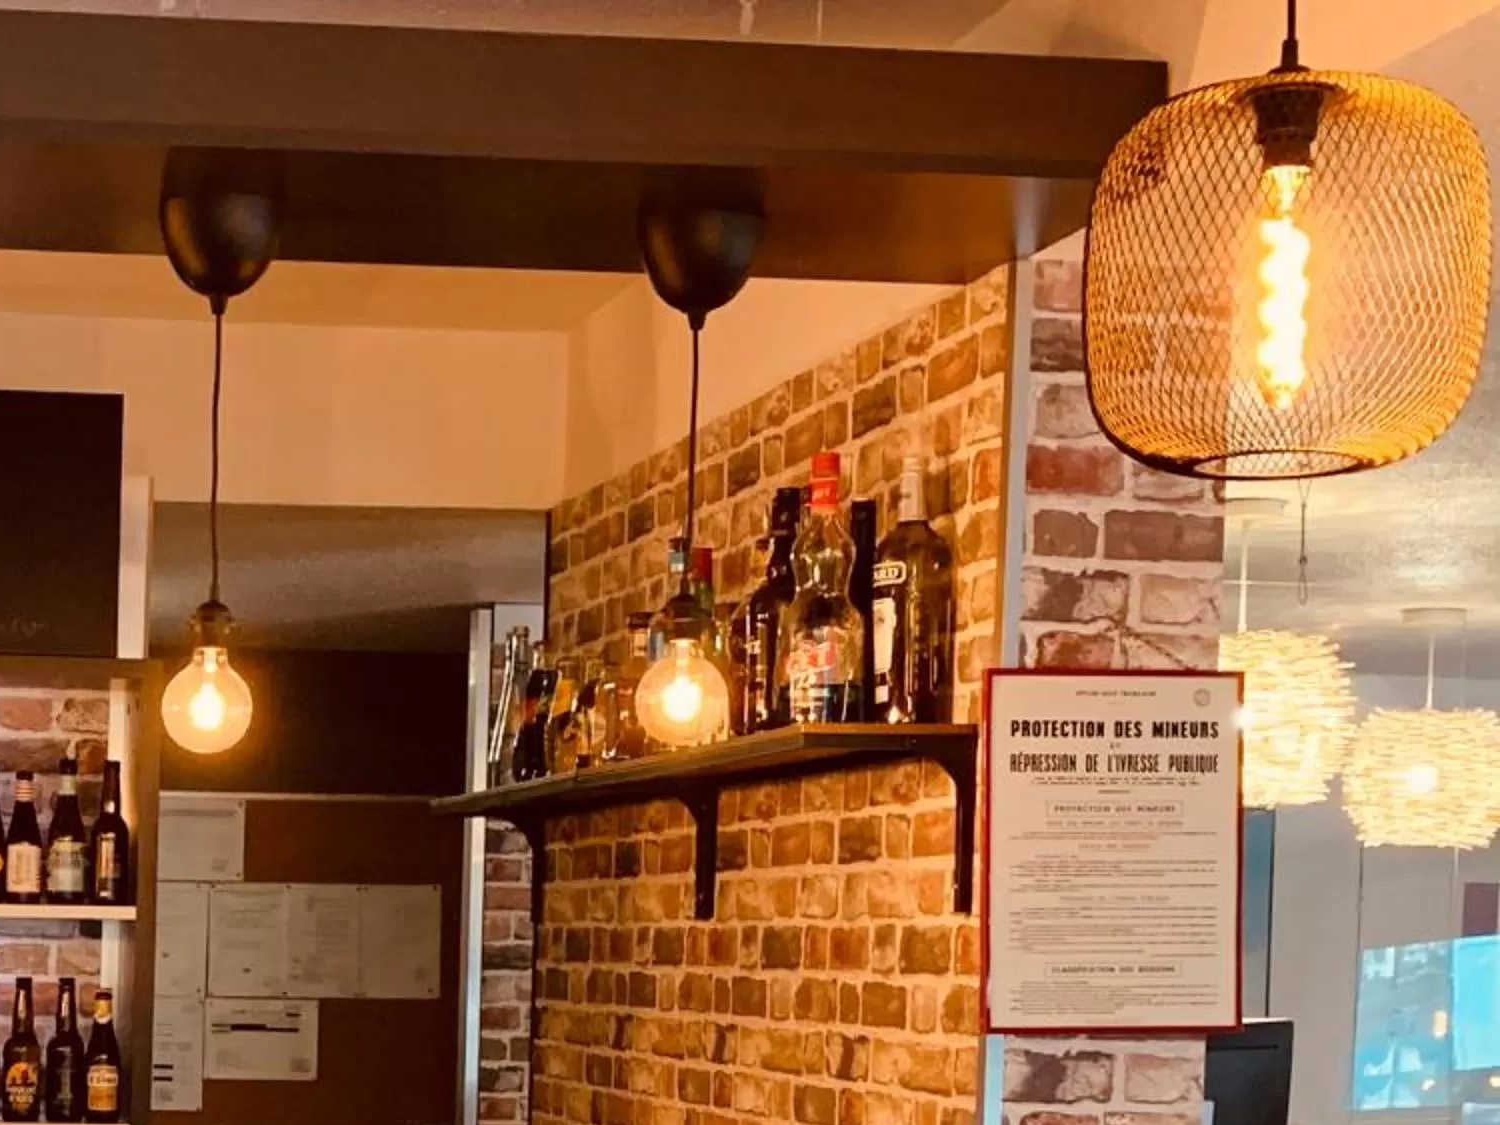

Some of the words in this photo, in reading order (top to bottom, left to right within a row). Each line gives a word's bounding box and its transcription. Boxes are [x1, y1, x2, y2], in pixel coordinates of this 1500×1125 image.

[1010, 719, 1105, 738] PROTECTION
[1114, 720, 1142, 738] DES
[1152, 720, 1219, 739] MINEURS
[1009, 751, 1077, 773] RÉPRESSION
[1085, 754, 1098, 773] DE
[1107, 753, 1159, 773] L'IVRESSE
[1169, 754, 1219, 774] PUBLIQUE
